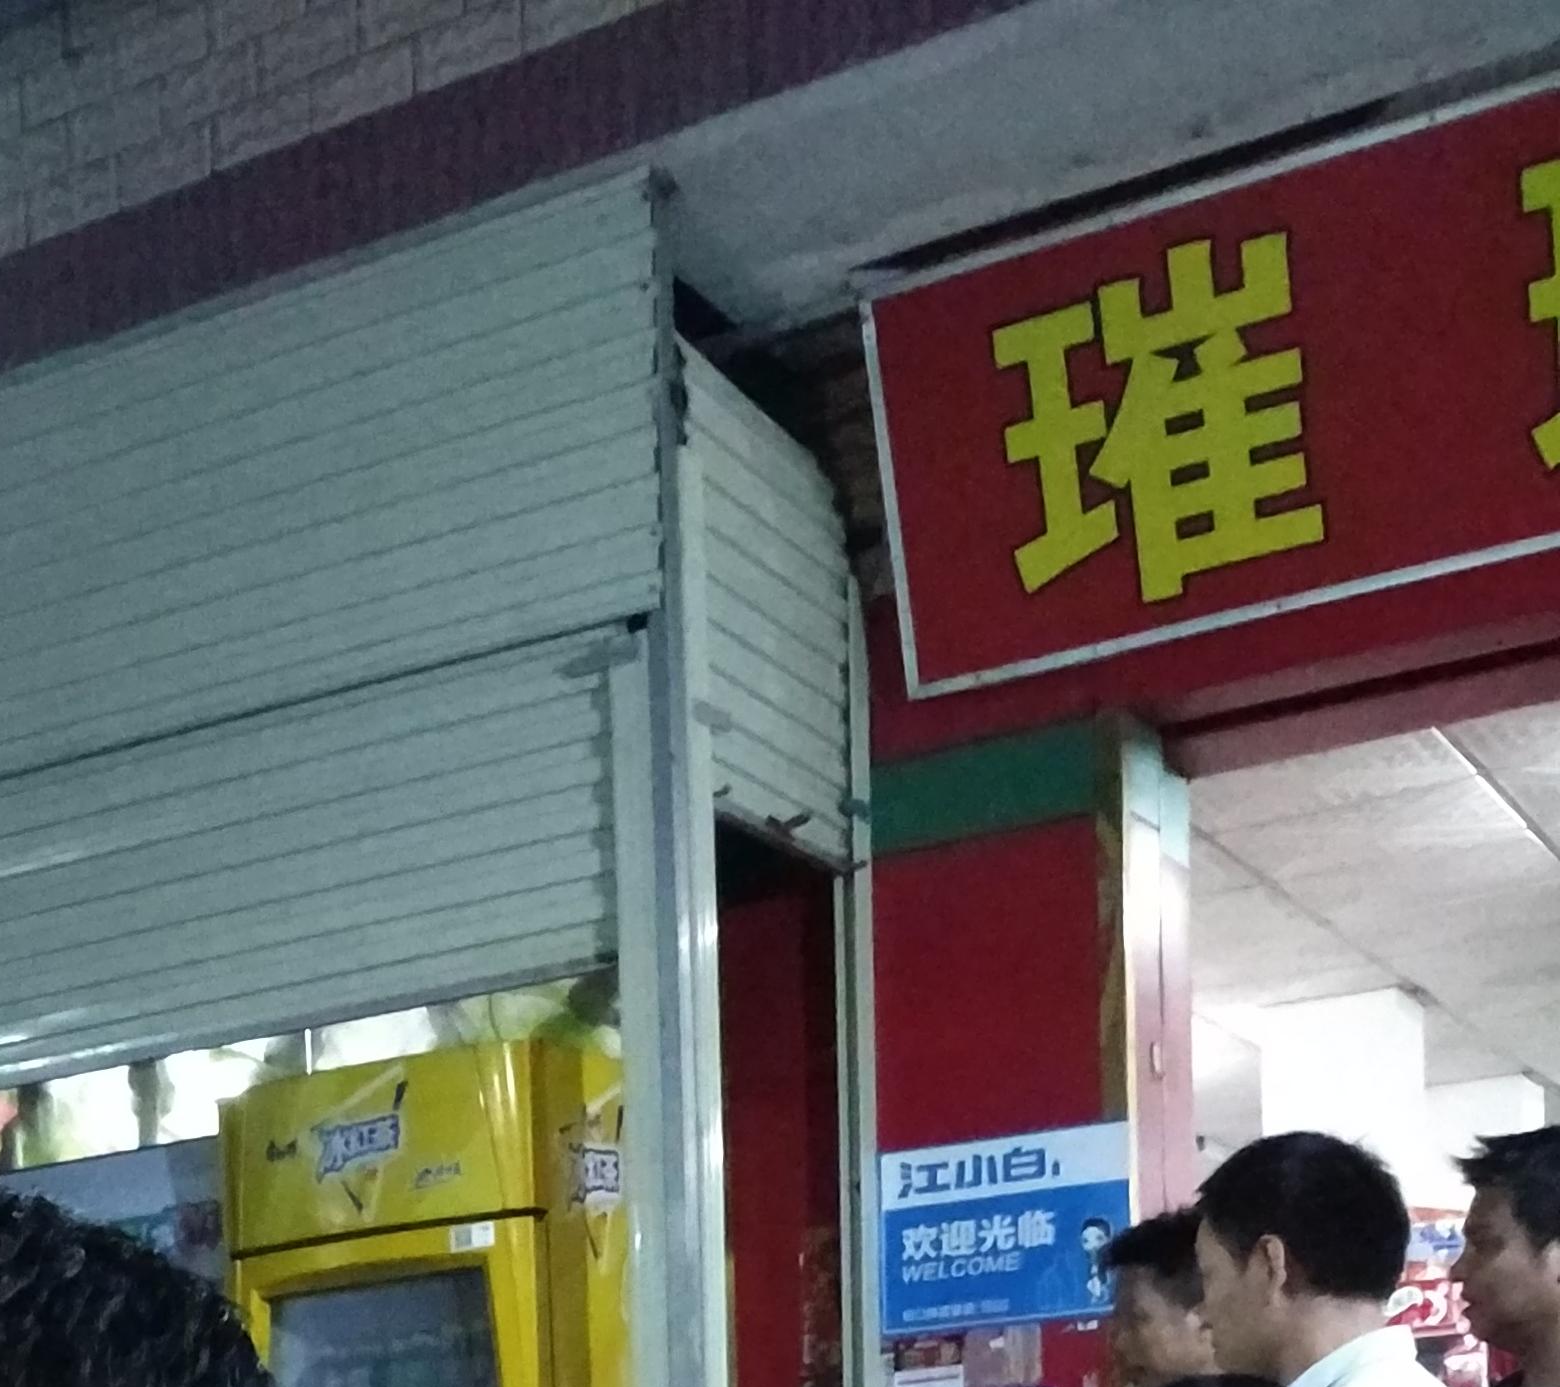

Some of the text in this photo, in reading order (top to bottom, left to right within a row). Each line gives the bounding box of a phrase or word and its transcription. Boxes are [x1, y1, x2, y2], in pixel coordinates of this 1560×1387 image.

[898, 1147, 1046, 1198] 江小白
[902, 1210, 1056, 1260] 欢迎光临
[903, 1252, 1021, 1283] WELCOME
